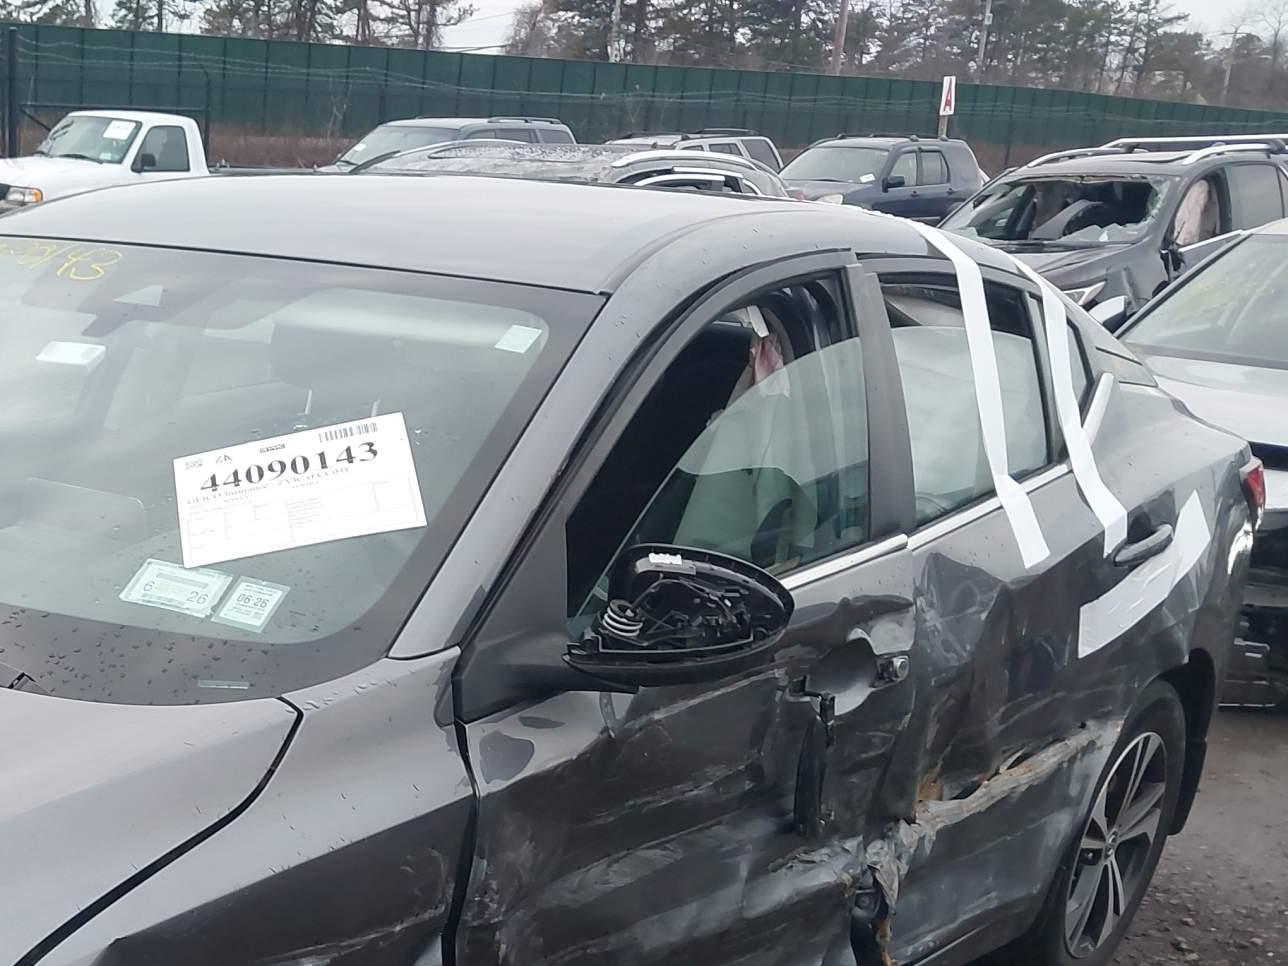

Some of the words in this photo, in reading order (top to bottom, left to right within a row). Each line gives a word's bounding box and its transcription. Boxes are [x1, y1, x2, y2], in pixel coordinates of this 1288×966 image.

[943, 77, 953, 112] A
[200, 441, 379, 492] 44090143
[143, 580, 155, 592] 6
[186, 590, 209, 605] 26
